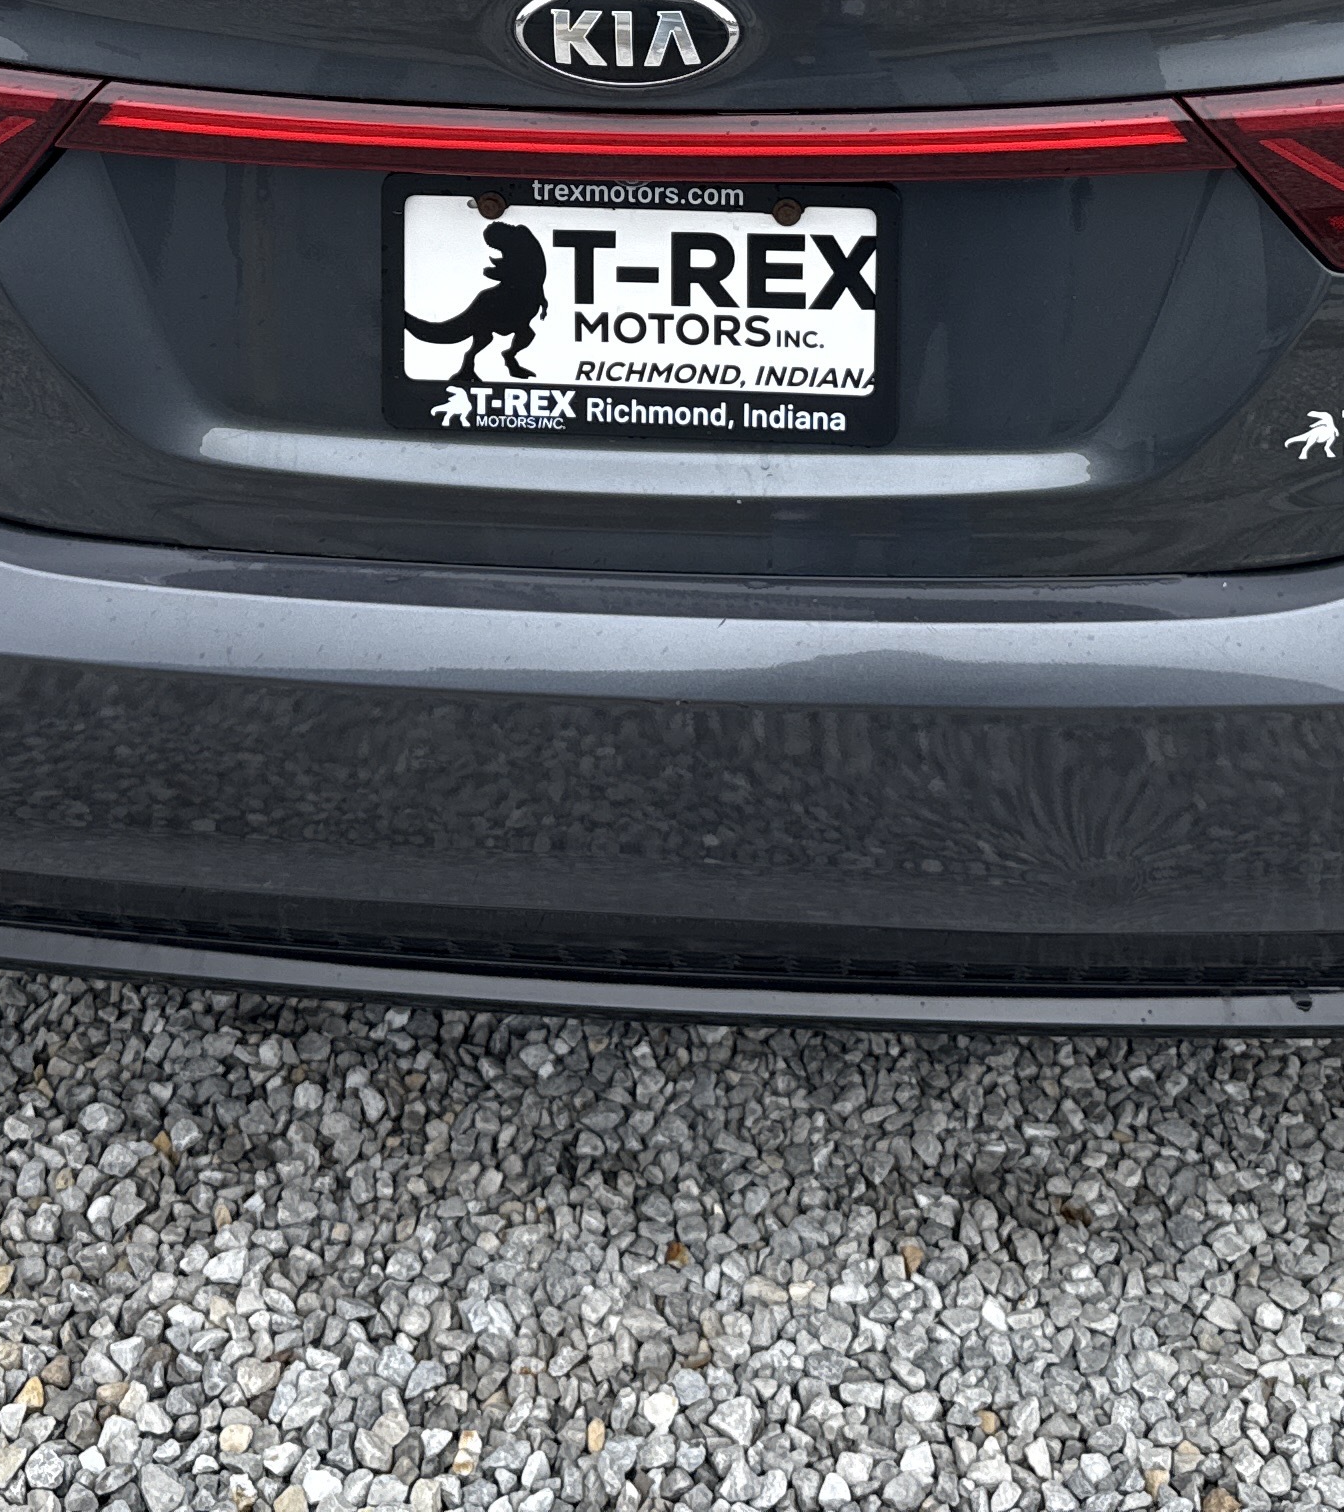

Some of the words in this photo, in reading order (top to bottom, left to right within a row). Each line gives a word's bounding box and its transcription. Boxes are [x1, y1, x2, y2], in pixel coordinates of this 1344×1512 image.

[551, 8, 702, 67] KIA
[532, 179, 745, 207] trexmotors.com
[553, 229, 877, 311] T-REX
[574, 312, 771, 348] MOTORS
[776, 329, 825, 349] INC.
[574, 361, 746, 389] RICHMOND,
[470, 388, 576, 419] T-REX
[586, 398, 734, 429] Richmond,
[743, 403, 846, 432] Indiana
[476, 417, 537, 429] MOTORS
